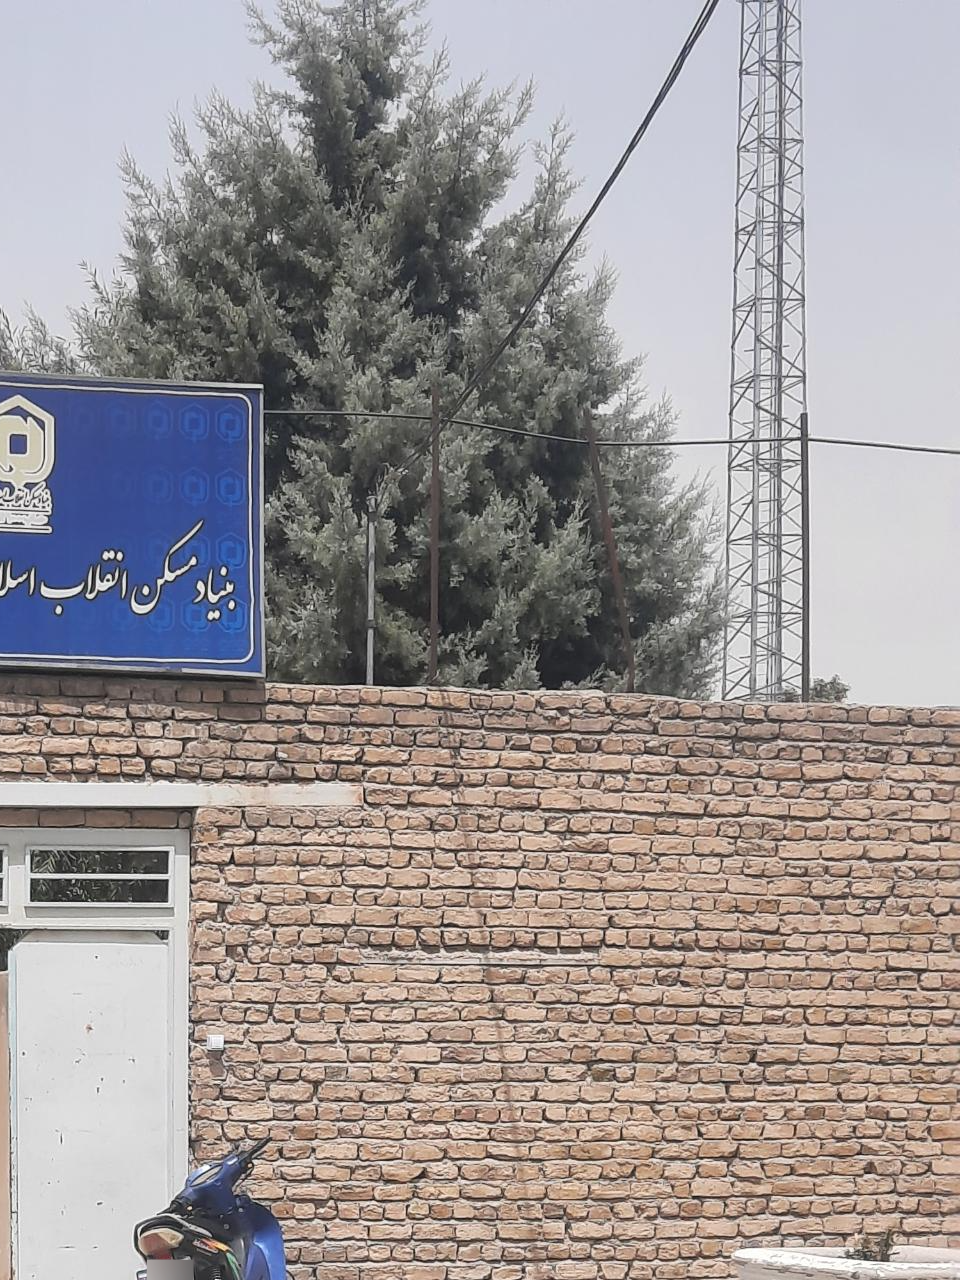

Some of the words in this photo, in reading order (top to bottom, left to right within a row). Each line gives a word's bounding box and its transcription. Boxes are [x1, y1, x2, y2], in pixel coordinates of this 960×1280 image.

[39, 550, 128, 616] انقلاب
[129, 519, 204, 615] مسکن
[194, 565, 237, 621] بنیاد
